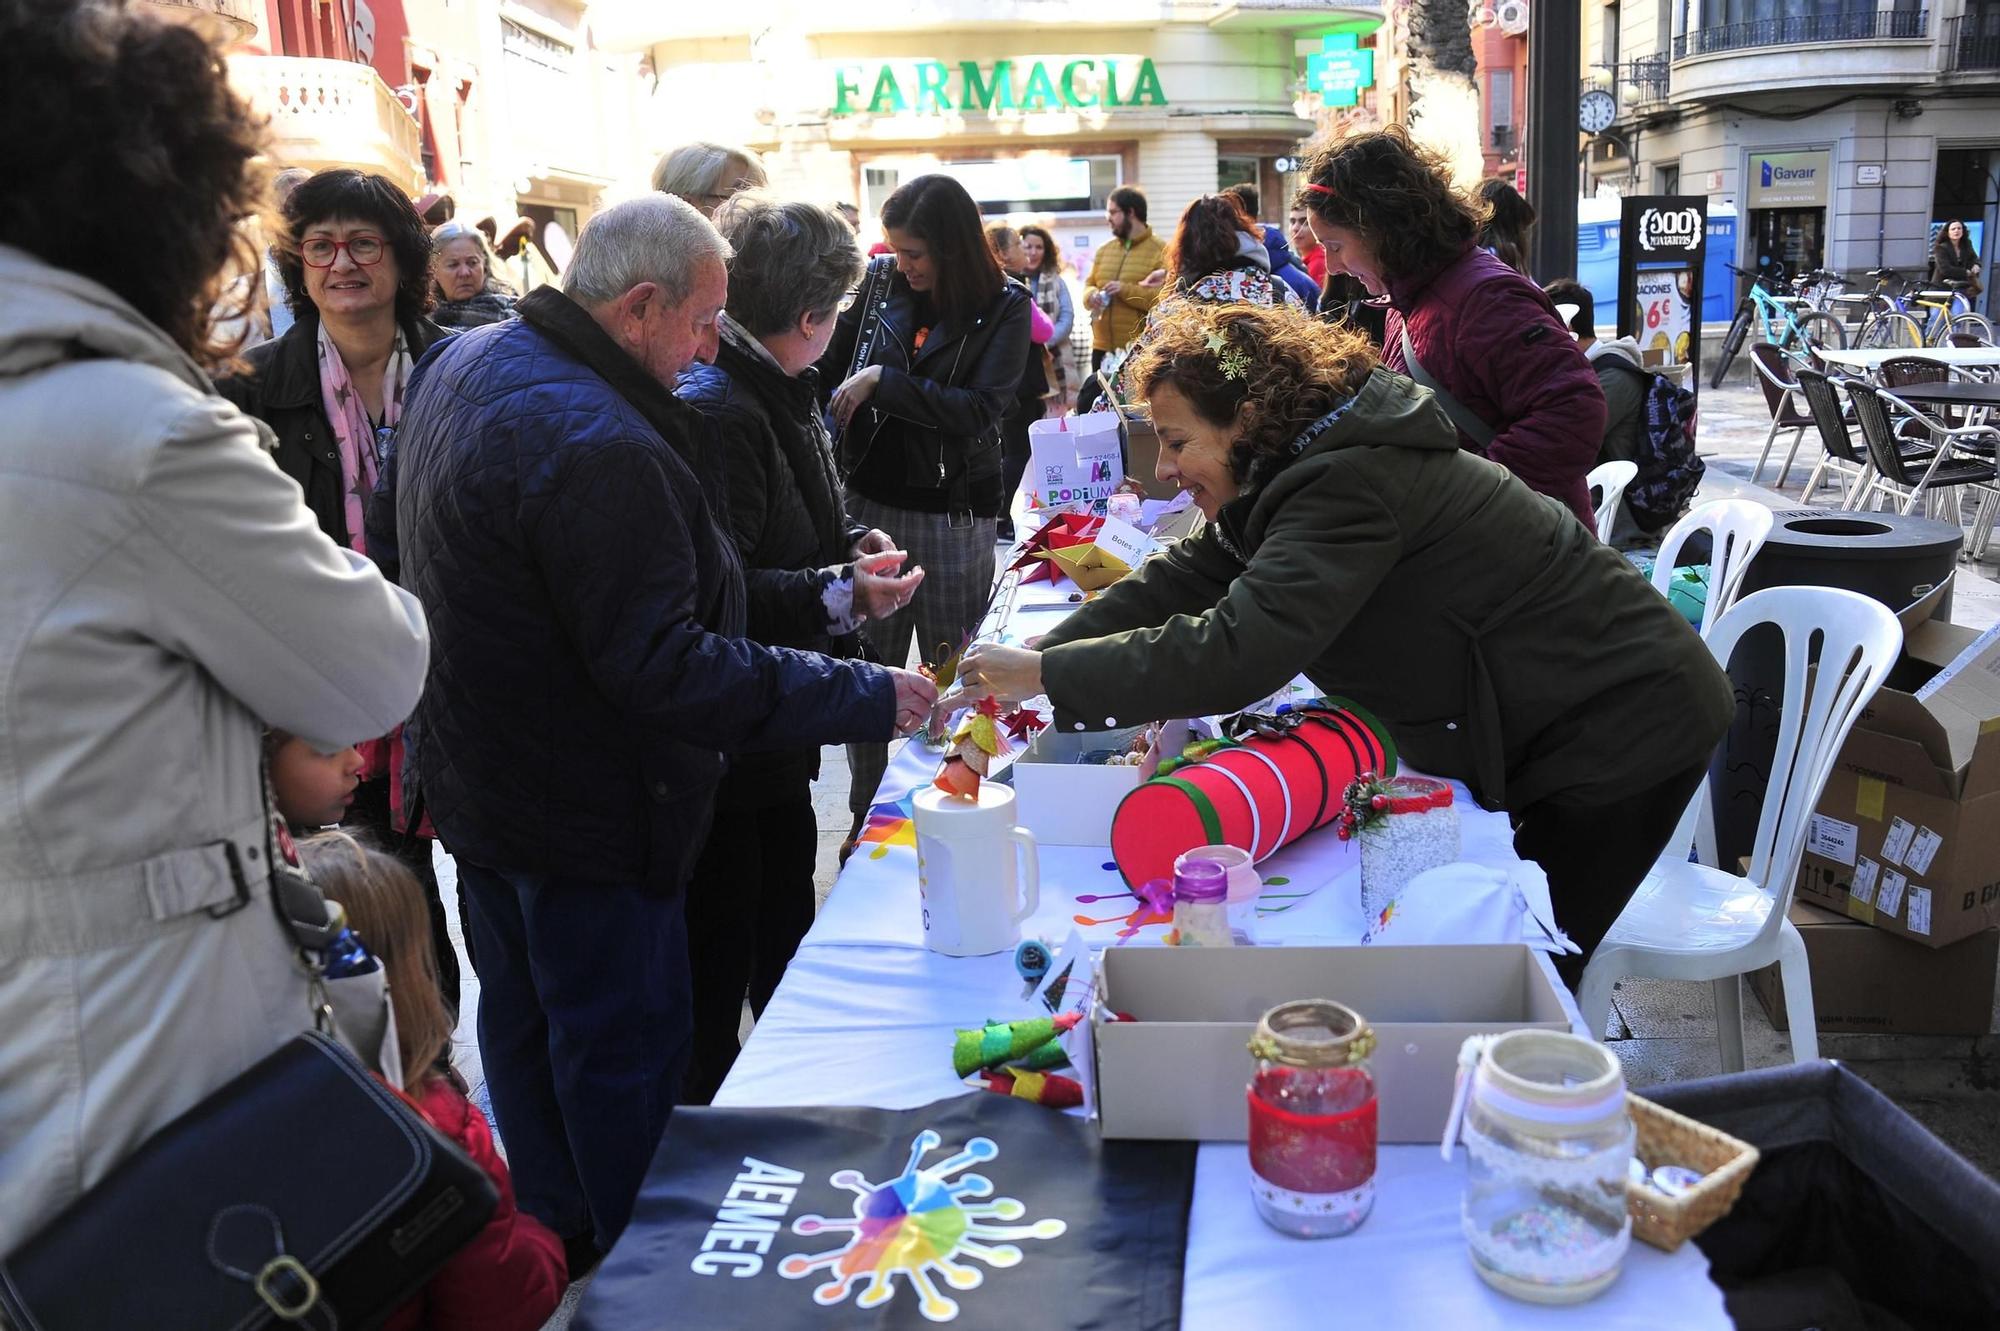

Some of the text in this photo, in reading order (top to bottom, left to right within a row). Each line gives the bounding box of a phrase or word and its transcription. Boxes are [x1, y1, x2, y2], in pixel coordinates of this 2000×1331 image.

[832, 57, 1169, 114] FARMACIA
[1774, 166, 1816, 180] Gavair
[1091, 460, 1112, 483] A4
[691, 1156, 805, 1277] AEMEC
